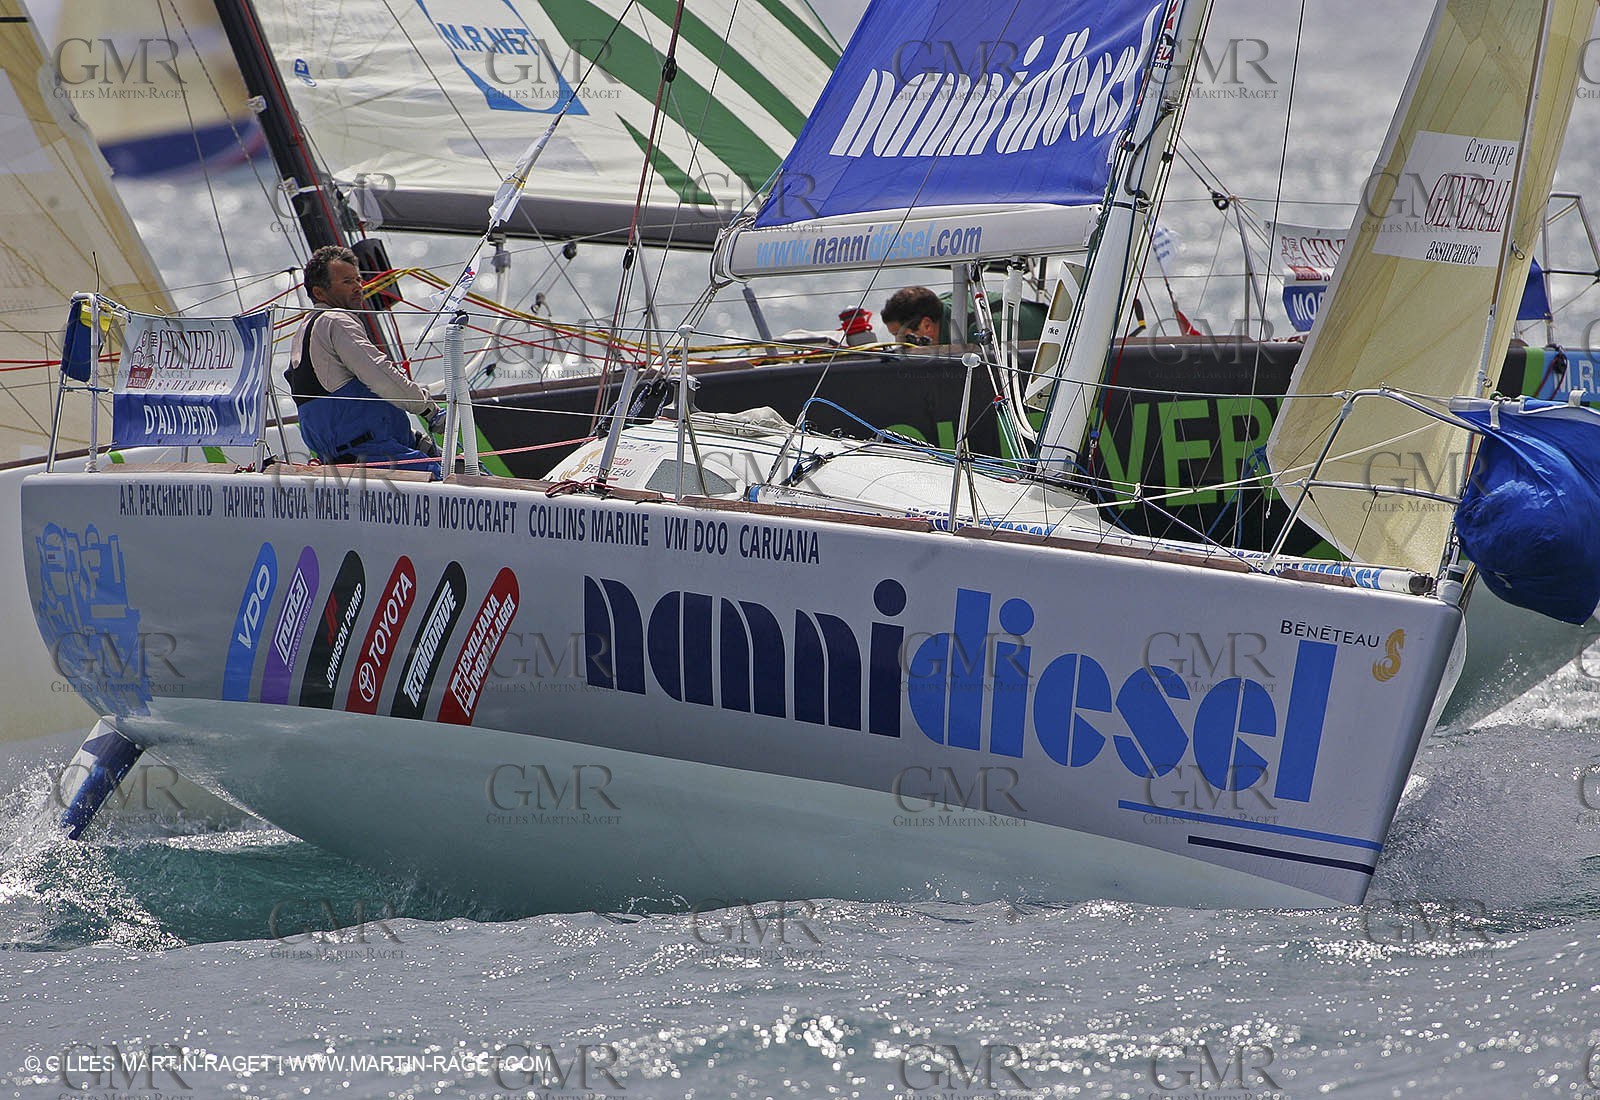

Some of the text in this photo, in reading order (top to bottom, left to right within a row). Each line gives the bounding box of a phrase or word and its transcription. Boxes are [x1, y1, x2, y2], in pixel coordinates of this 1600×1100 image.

[436, 22, 540, 56] M.R.NET
[1464, 137, 1515, 175] Groupe
[756, 224, 984, 267] www.nannidiesel.com
[1425, 239, 1482, 265] assurances
[157, 330, 236, 370] GENERALI
[143, 404, 219, 436] D'ALI PIETRO
[119, 484, 821, 565] A.R. PEACHMENT LTD TAPIMER NOGVA MALTE MANSON AB MOTOCRAFT COLLINS MARINE VM DOO CARUANA
[237, 564, 271, 649] VDO
[325, 583, 362, 688] JOHNSON PUMP
[368, 572, 413, 668] TOYOTA
[460, 593, 501, 671] EMILIANA
[469, 593, 516, 690] IMBALLAGGI
